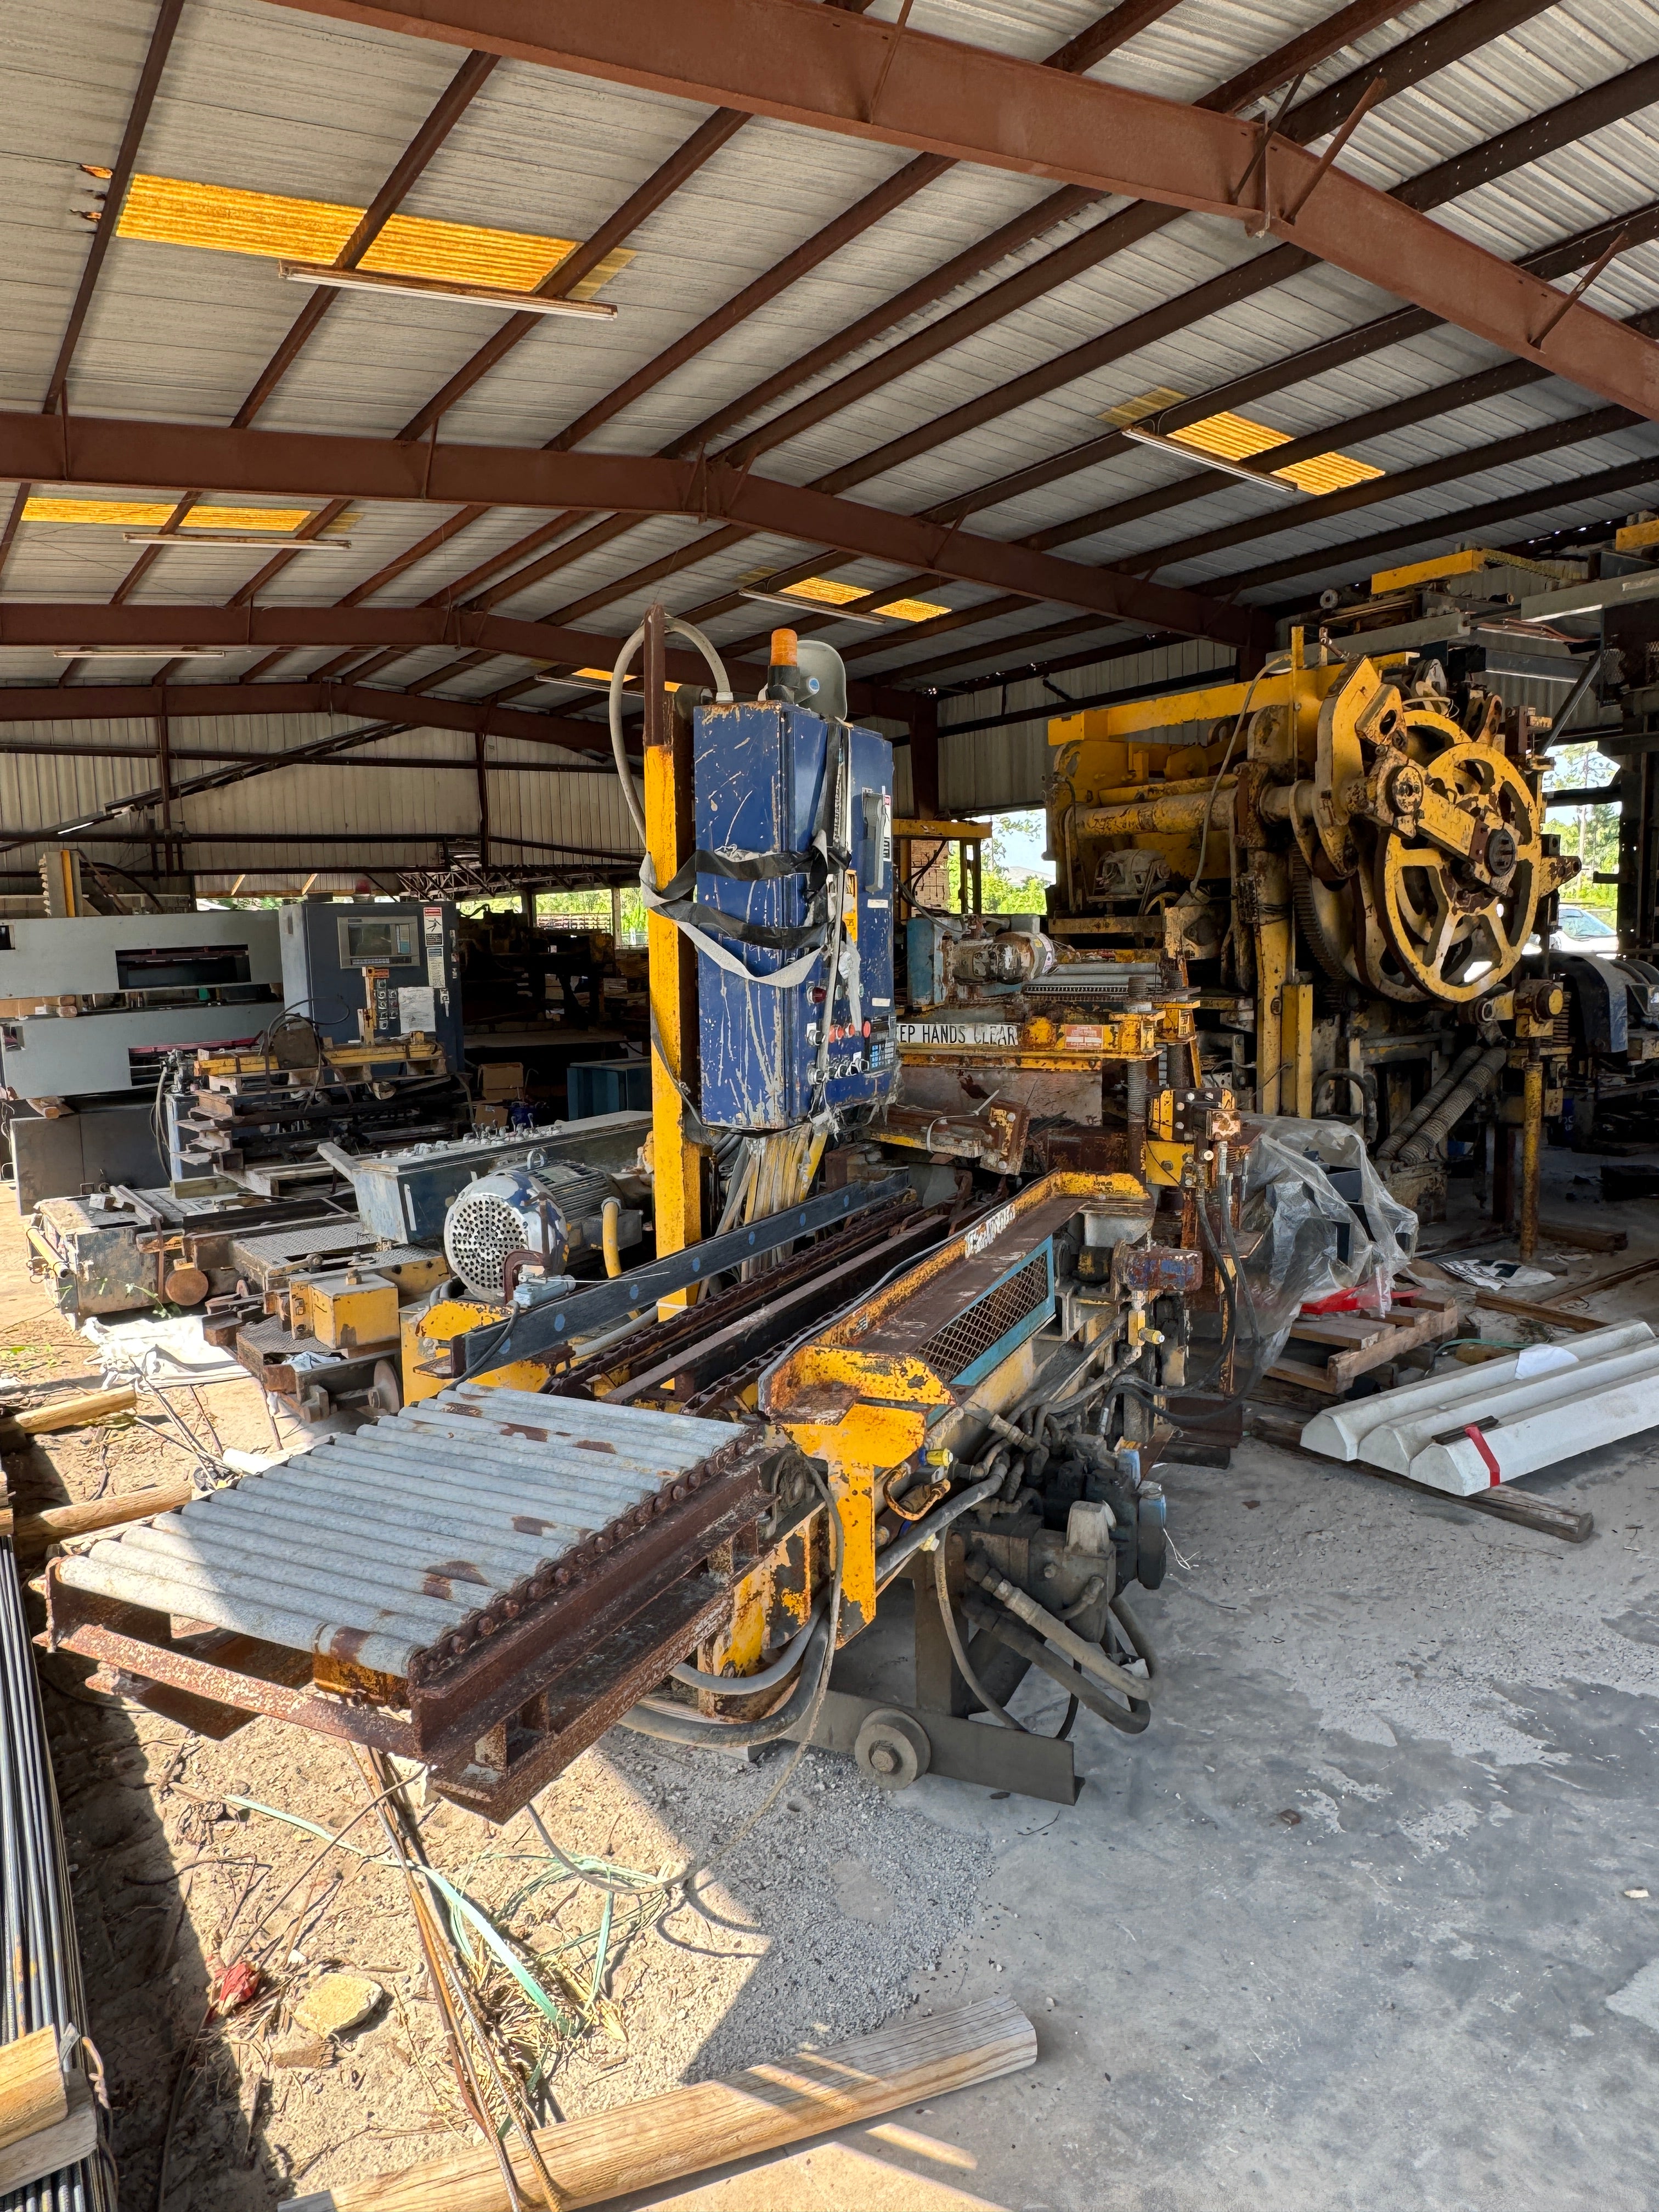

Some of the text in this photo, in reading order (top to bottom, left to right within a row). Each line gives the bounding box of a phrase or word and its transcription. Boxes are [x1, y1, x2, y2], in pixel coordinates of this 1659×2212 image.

[895, 1024, 1015, 1046] EP HANDS CLEAR
